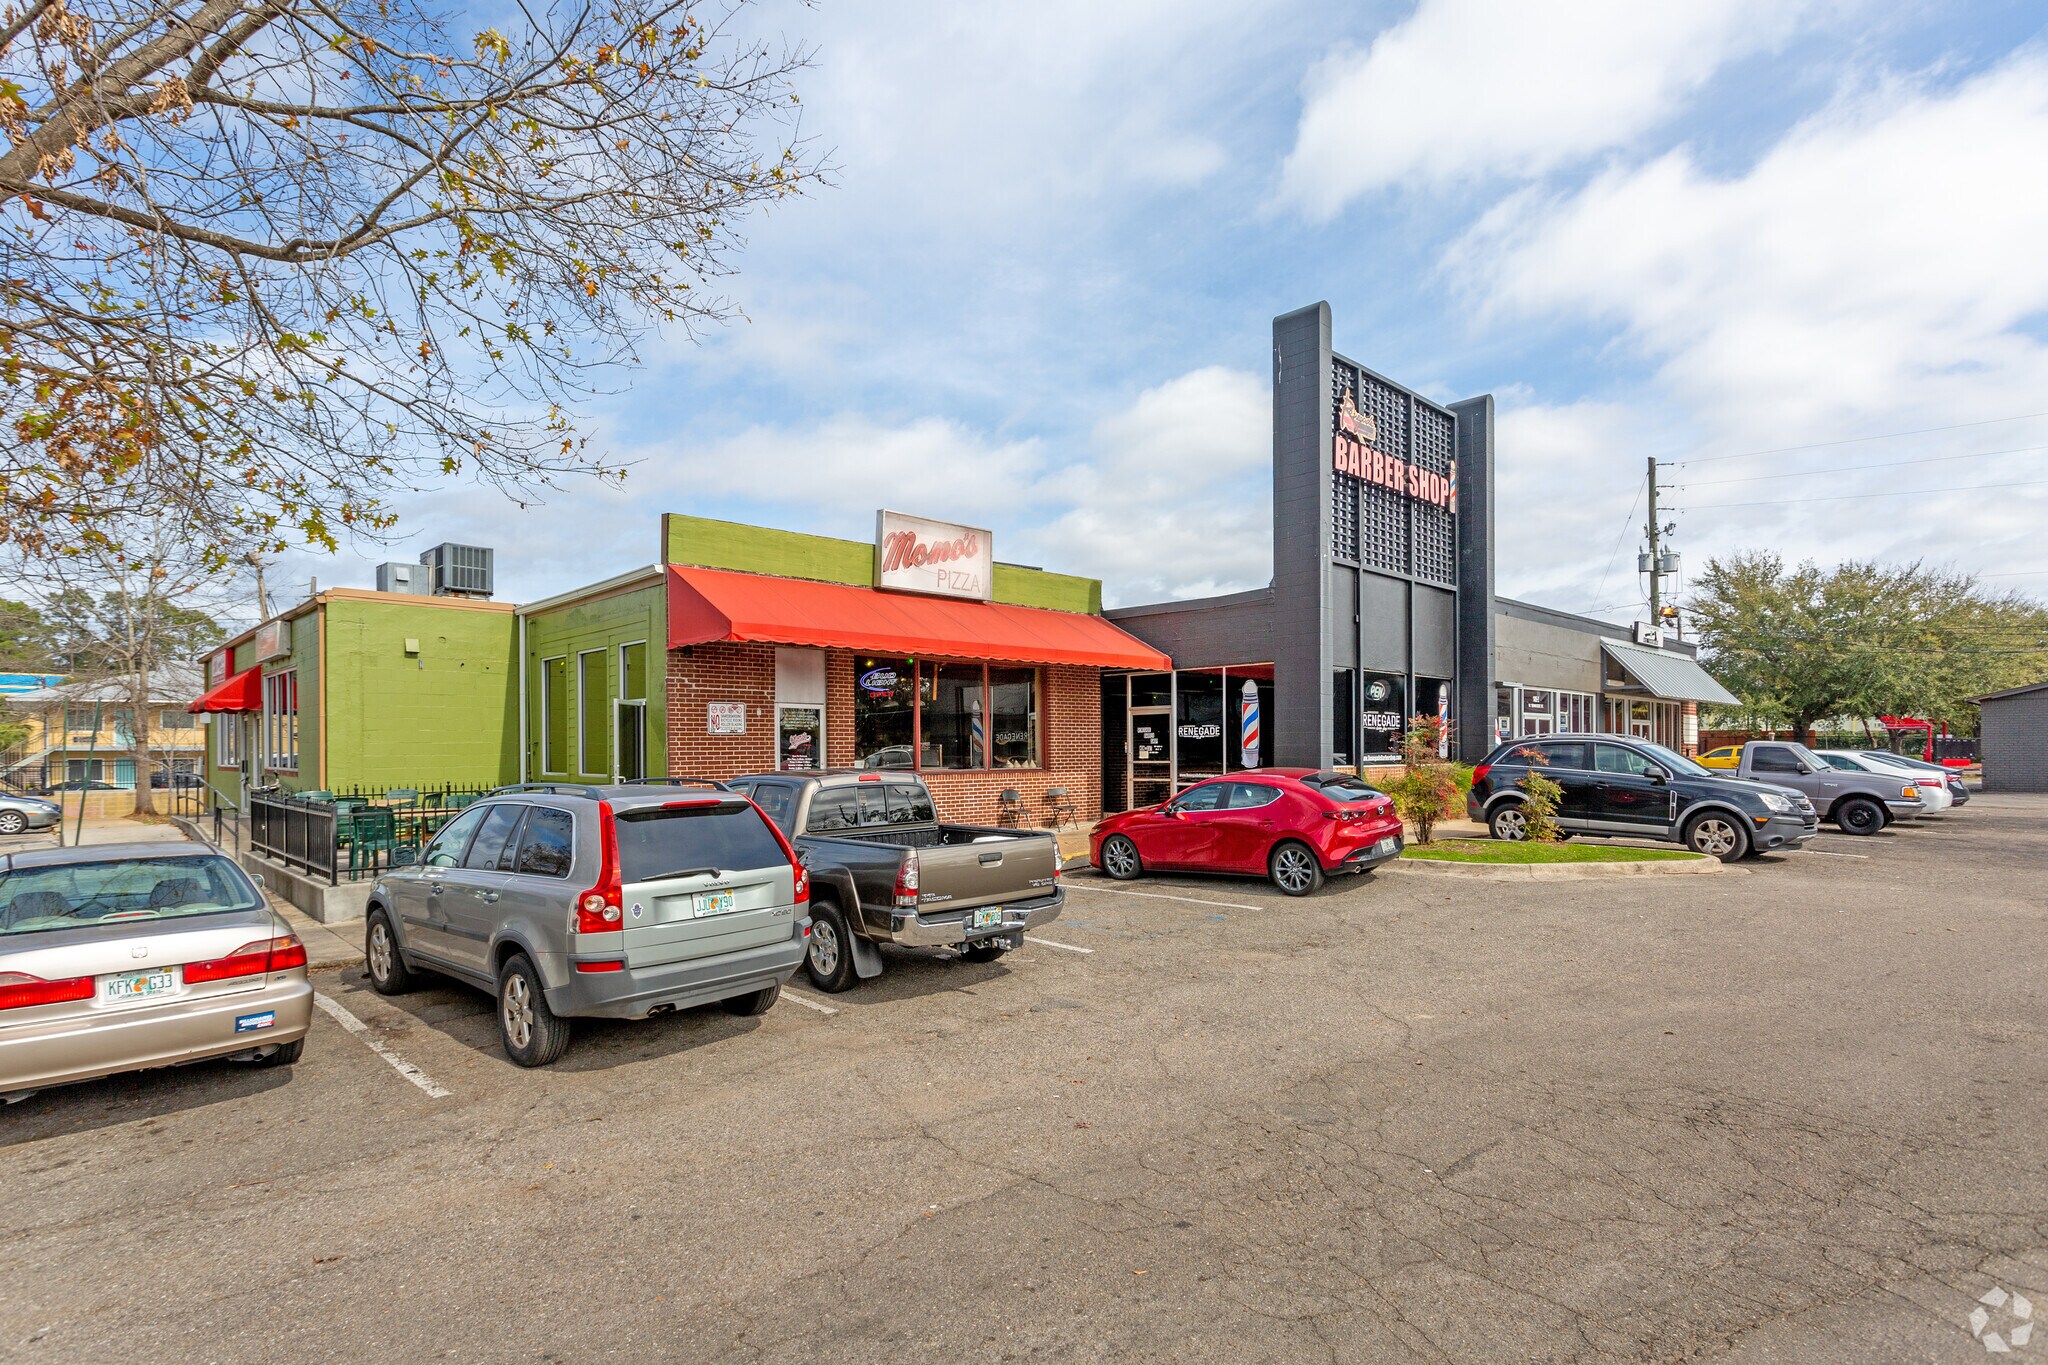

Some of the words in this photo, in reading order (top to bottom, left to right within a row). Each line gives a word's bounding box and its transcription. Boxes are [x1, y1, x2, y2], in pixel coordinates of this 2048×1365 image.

[1335, 435, 1404, 492] BARBER
[1408, 464, 1449, 507] SHOP
[883, 530, 978, 573] Momo's
[937, 569, 981, 592] PIZZA
[1363, 714, 1400, 727] RENEGADE
[1178, 726, 1220, 736] RENEGADE
[703, 880, 731, 888] VOLVO
[921, 894, 952, 902] TACOMA
[108, 978, 133, 996] KFK
[148, 973, 172, 990] G33
